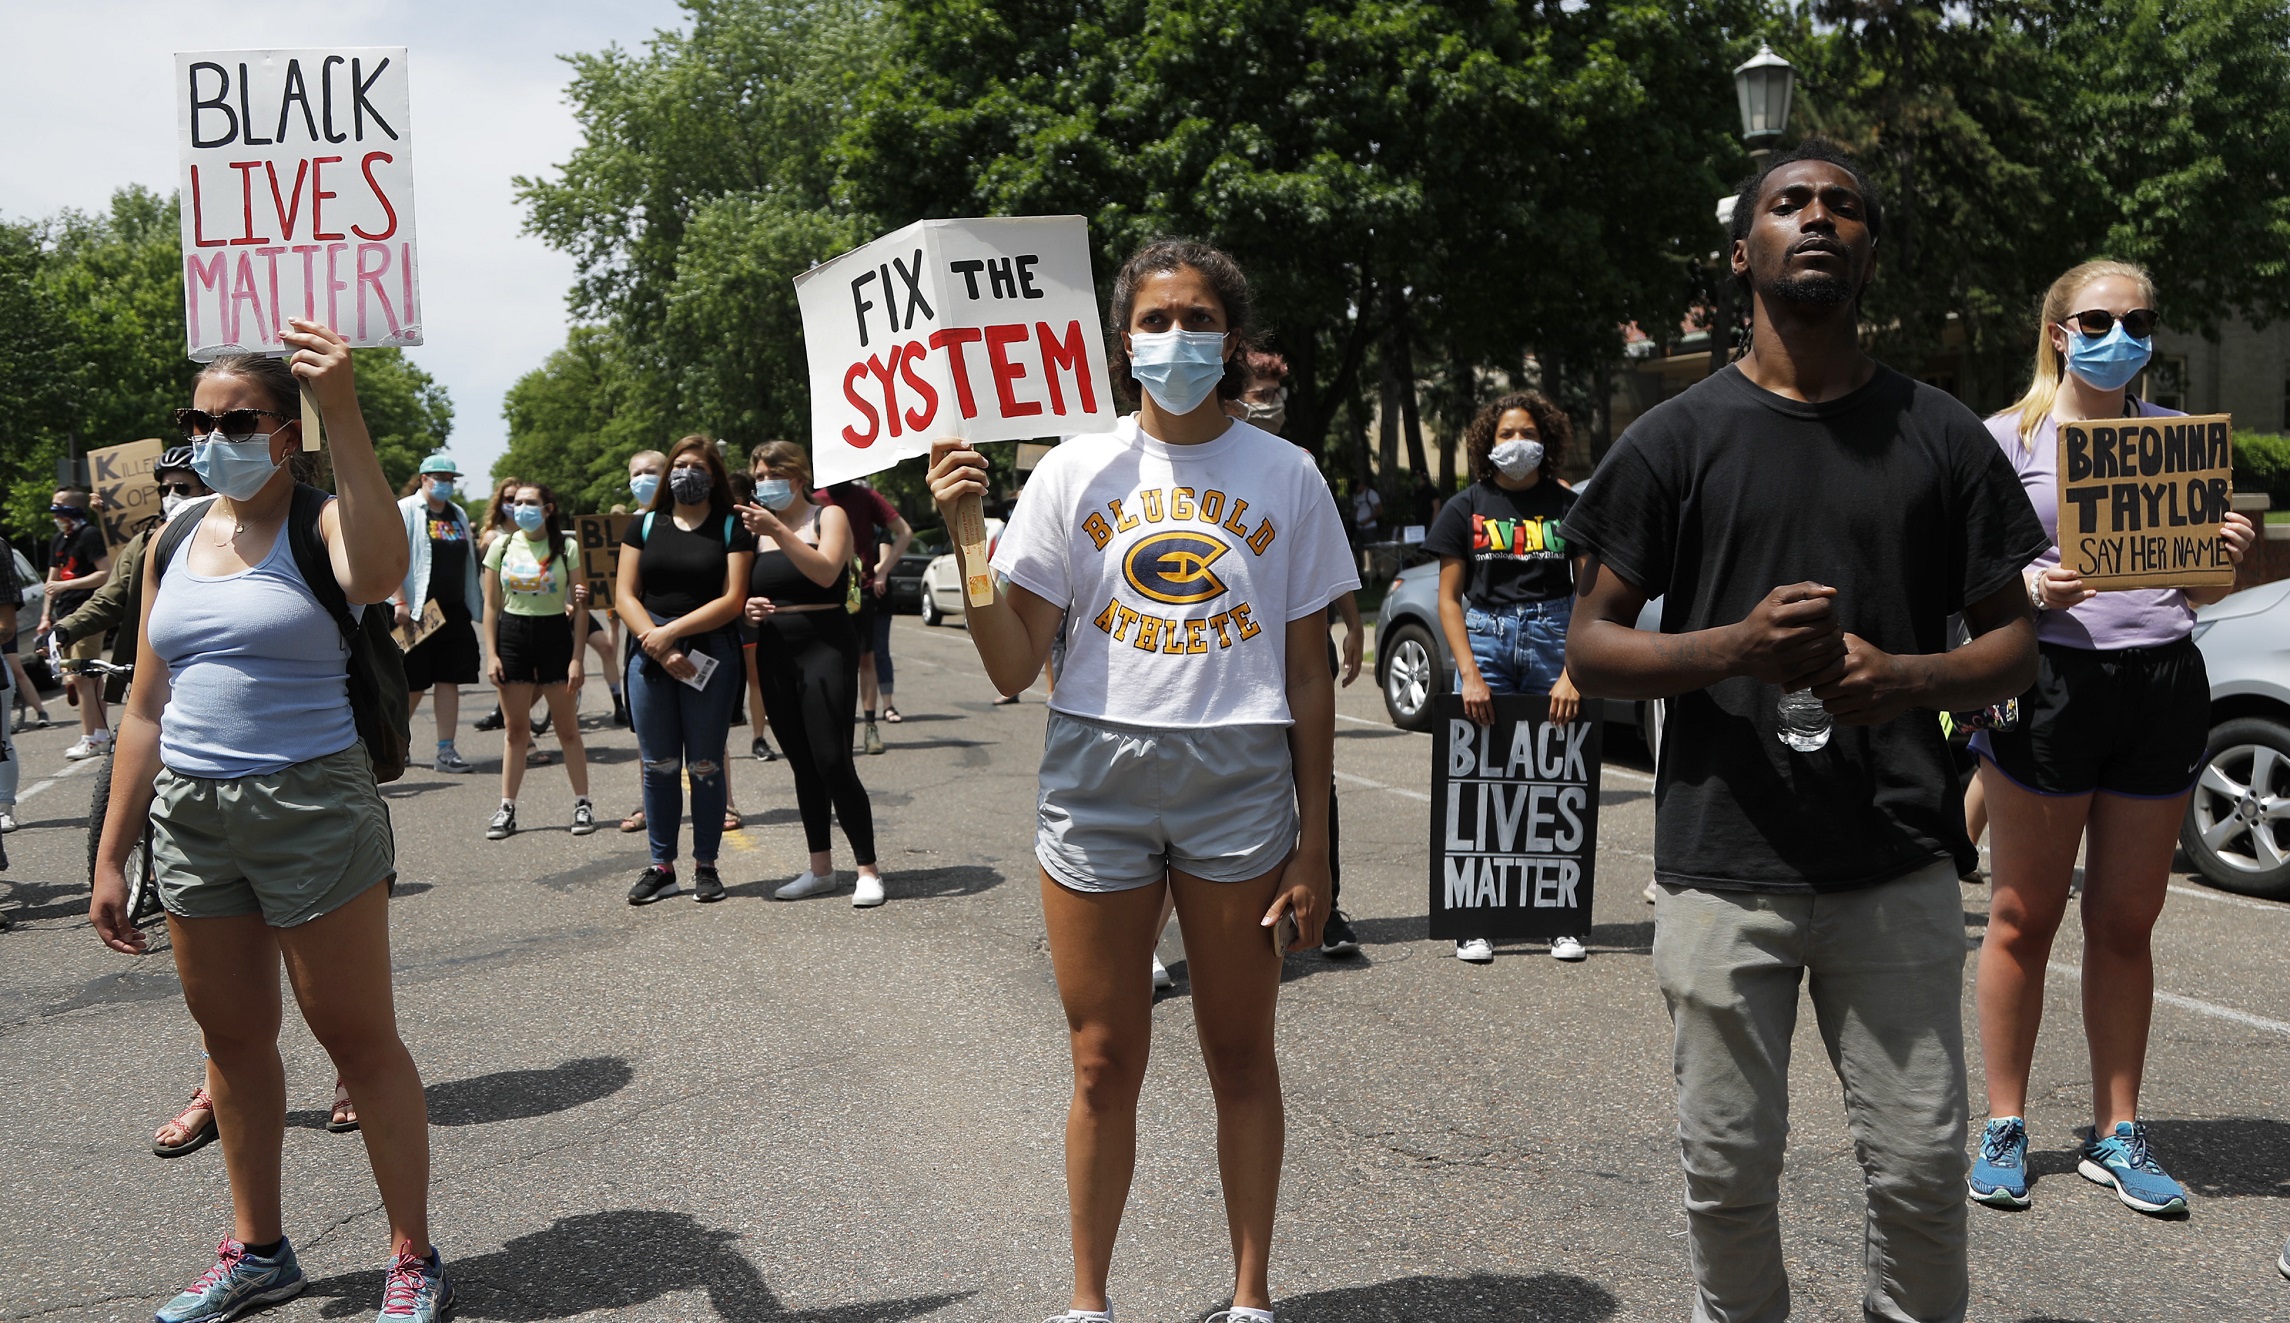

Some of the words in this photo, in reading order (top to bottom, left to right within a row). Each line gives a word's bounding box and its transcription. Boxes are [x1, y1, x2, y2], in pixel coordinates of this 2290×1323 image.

[189, 55, 399, 148] BLACK
[190, 151, 398, 247] LIVES
[187, 242, 416, 348] MATTER!
[851, 248, 934, 347] FIX
[950, 254, 1044, 300] THE
[842, 319, 1097, 449] SYSTEM
[2066, 422, 2228, 483] BREONNA
[1082, 487, 1276, 556] BLUGOLD
[1472, 513, 1567, 554] LIVING
[2066, 478, 2230, 534] TAYLOR
[2078, 536, 2124, 575] SAY
[2130, 535, 2167, 572] HER
[2173, 535, 2230, 569] NAME
[1093, 597, 1262, 655] ATHLETE
[1449, 719, 1592, 781] BLACK
[1445, 783, 1587, 853] LIVES
[1444, 857, 1581, 910] MATTER
